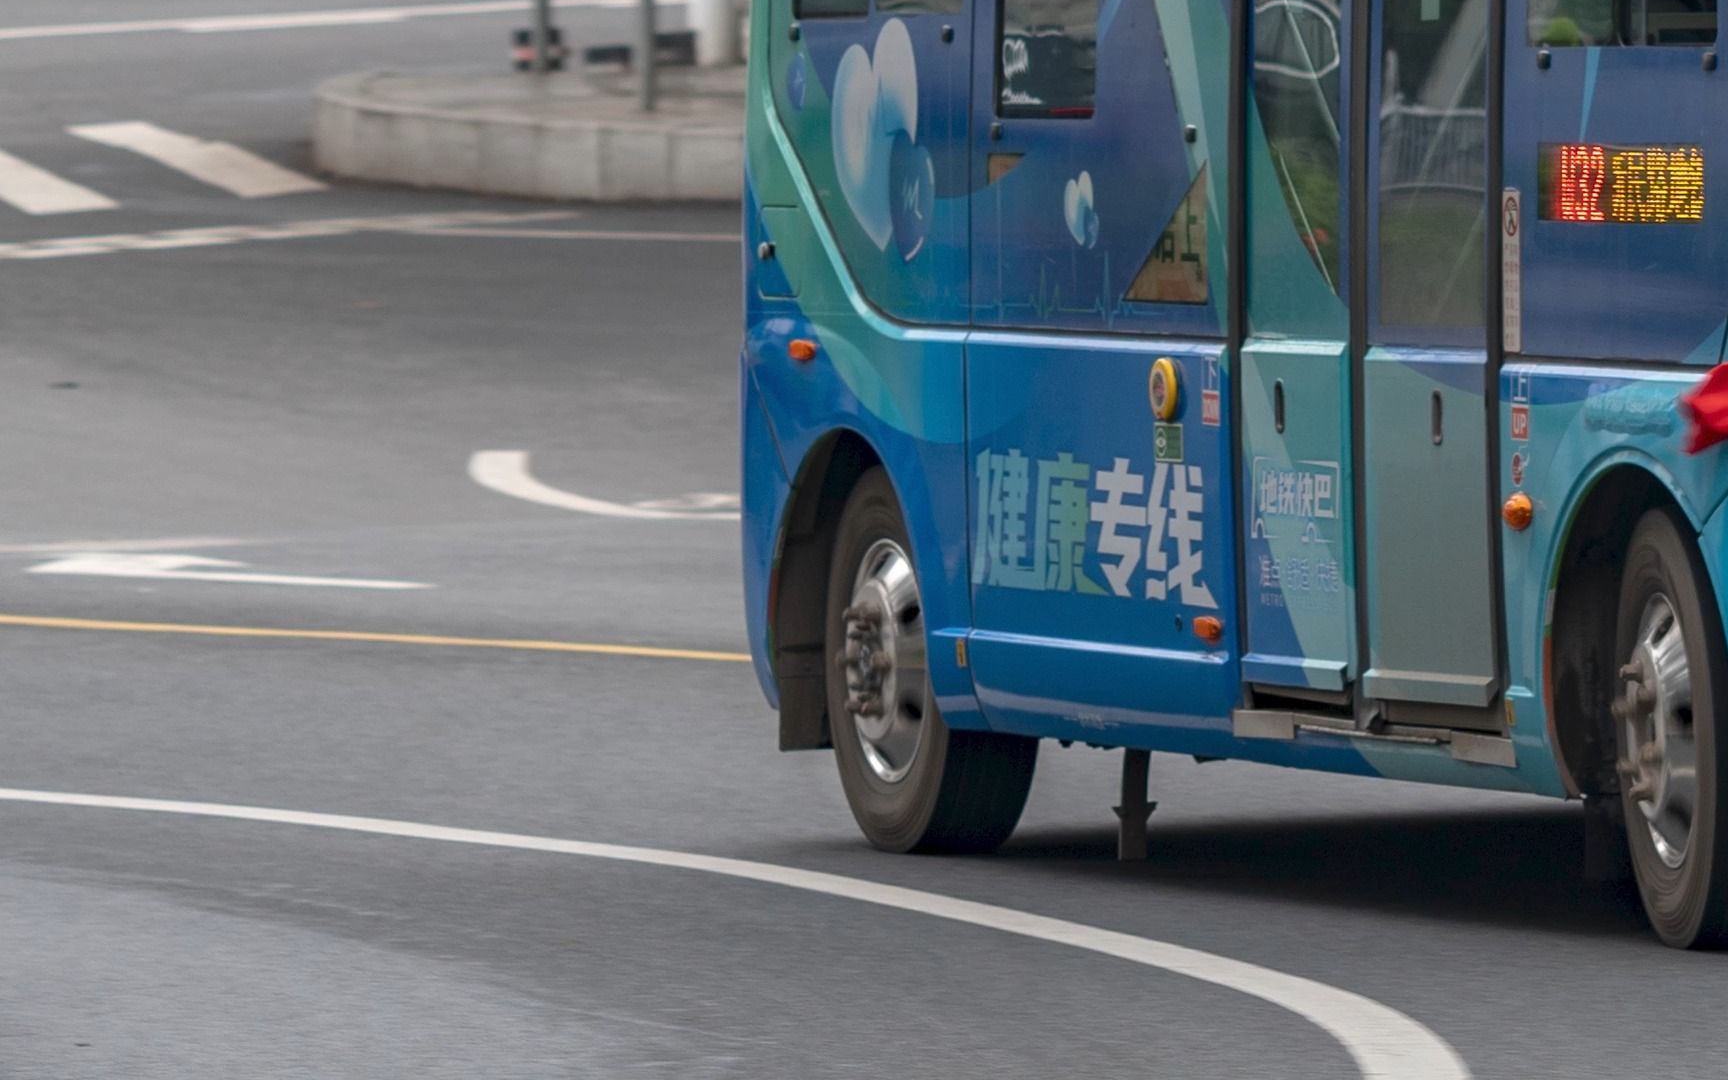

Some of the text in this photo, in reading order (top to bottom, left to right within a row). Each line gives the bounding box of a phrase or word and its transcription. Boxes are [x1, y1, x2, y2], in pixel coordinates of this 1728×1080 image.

[1204, 356, 1217, 389] 下
[1513, 376, 1528, 402] 上
[1513, 414, 1527, 437] UP
[1259, 470, 1335, 518] 地铁快巴
[971, 448, 1219, 610] 健康专线
